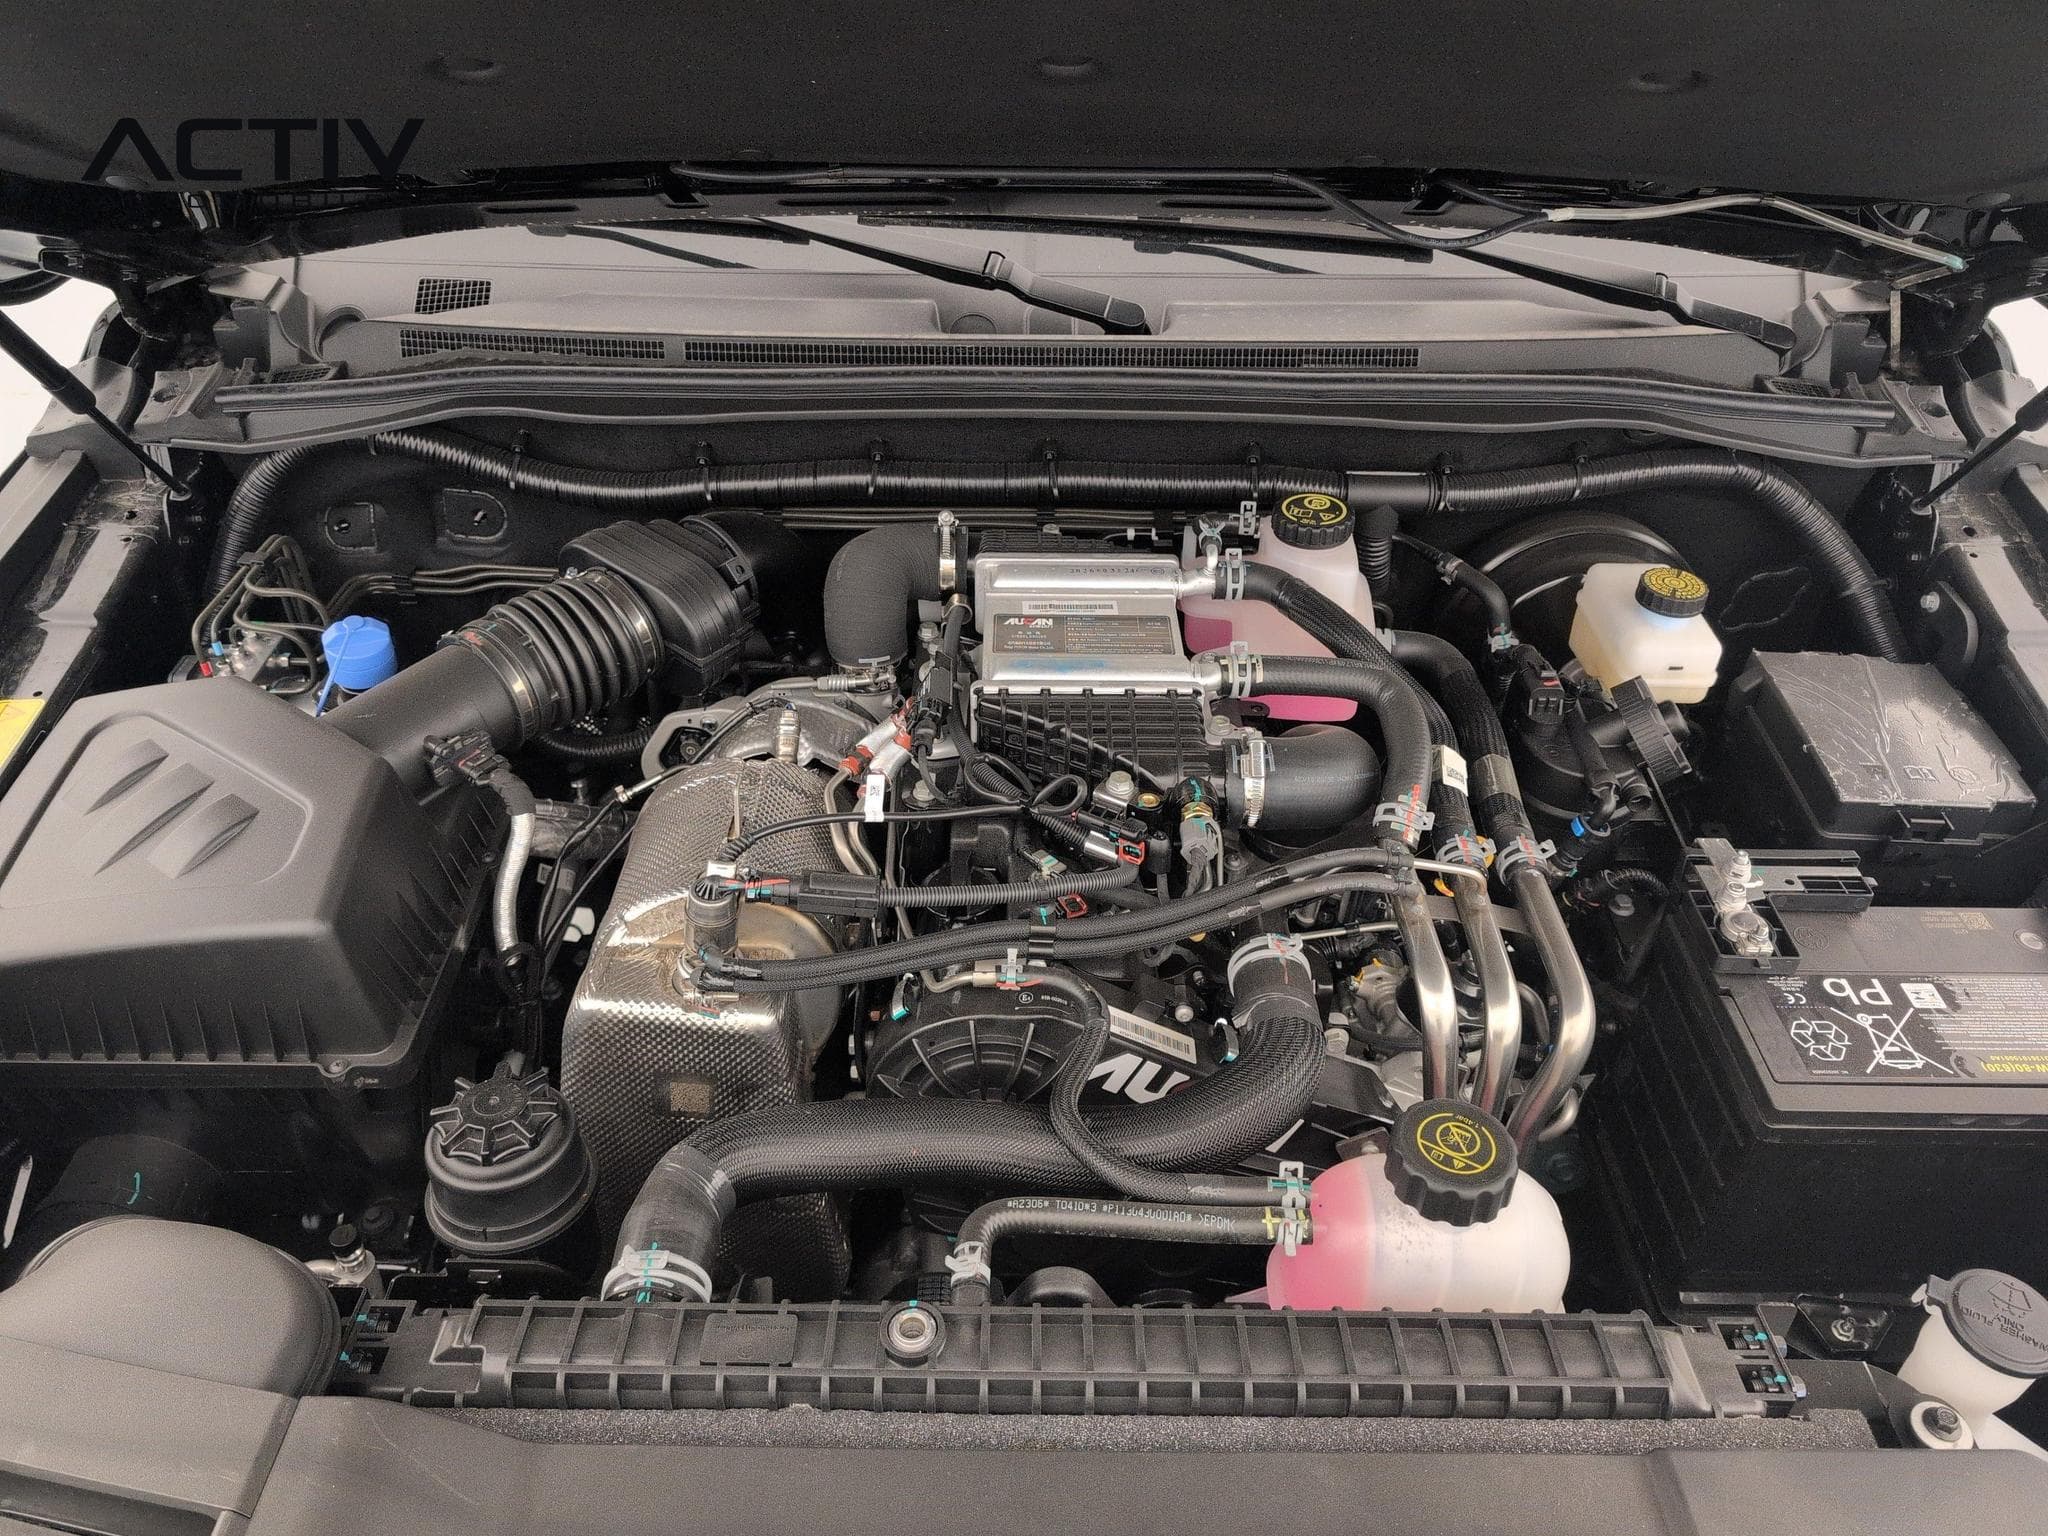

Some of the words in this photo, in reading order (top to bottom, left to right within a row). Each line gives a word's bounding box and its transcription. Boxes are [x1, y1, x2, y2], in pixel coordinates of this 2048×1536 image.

[1823, 978, 1892, 1006] Pb
[1088, 1053, 1192, 1104] AU
[1992, 1314, 2025, 1332] ONLY
